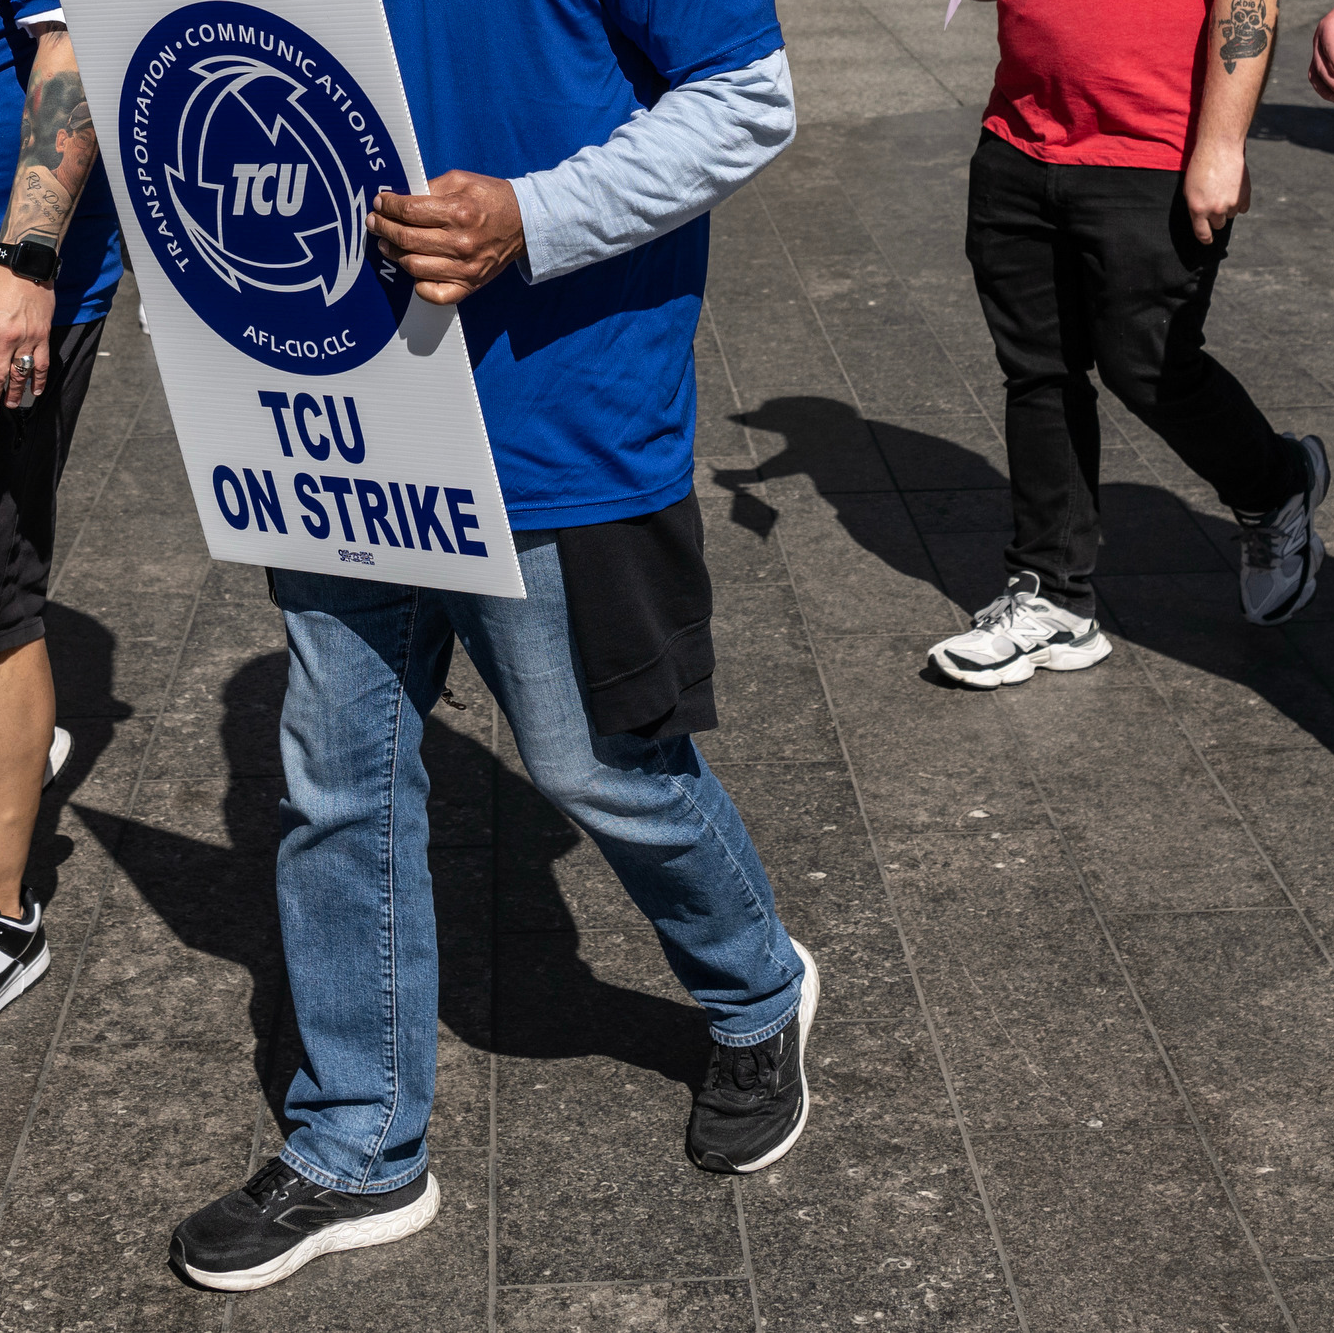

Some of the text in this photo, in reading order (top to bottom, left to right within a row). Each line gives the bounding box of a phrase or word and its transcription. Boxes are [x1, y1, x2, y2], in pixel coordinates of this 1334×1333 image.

[133, 45, 197, 273] TRANSPORTATION
[185, 23, 386, 172] COMMUNICATIONS
[42, 189, 65, 218] Dad
[232, 162, 309, 217] TCU
[257, 389, 366, 465] TCU
[212, 464, 489, 557] ON STRIKE
